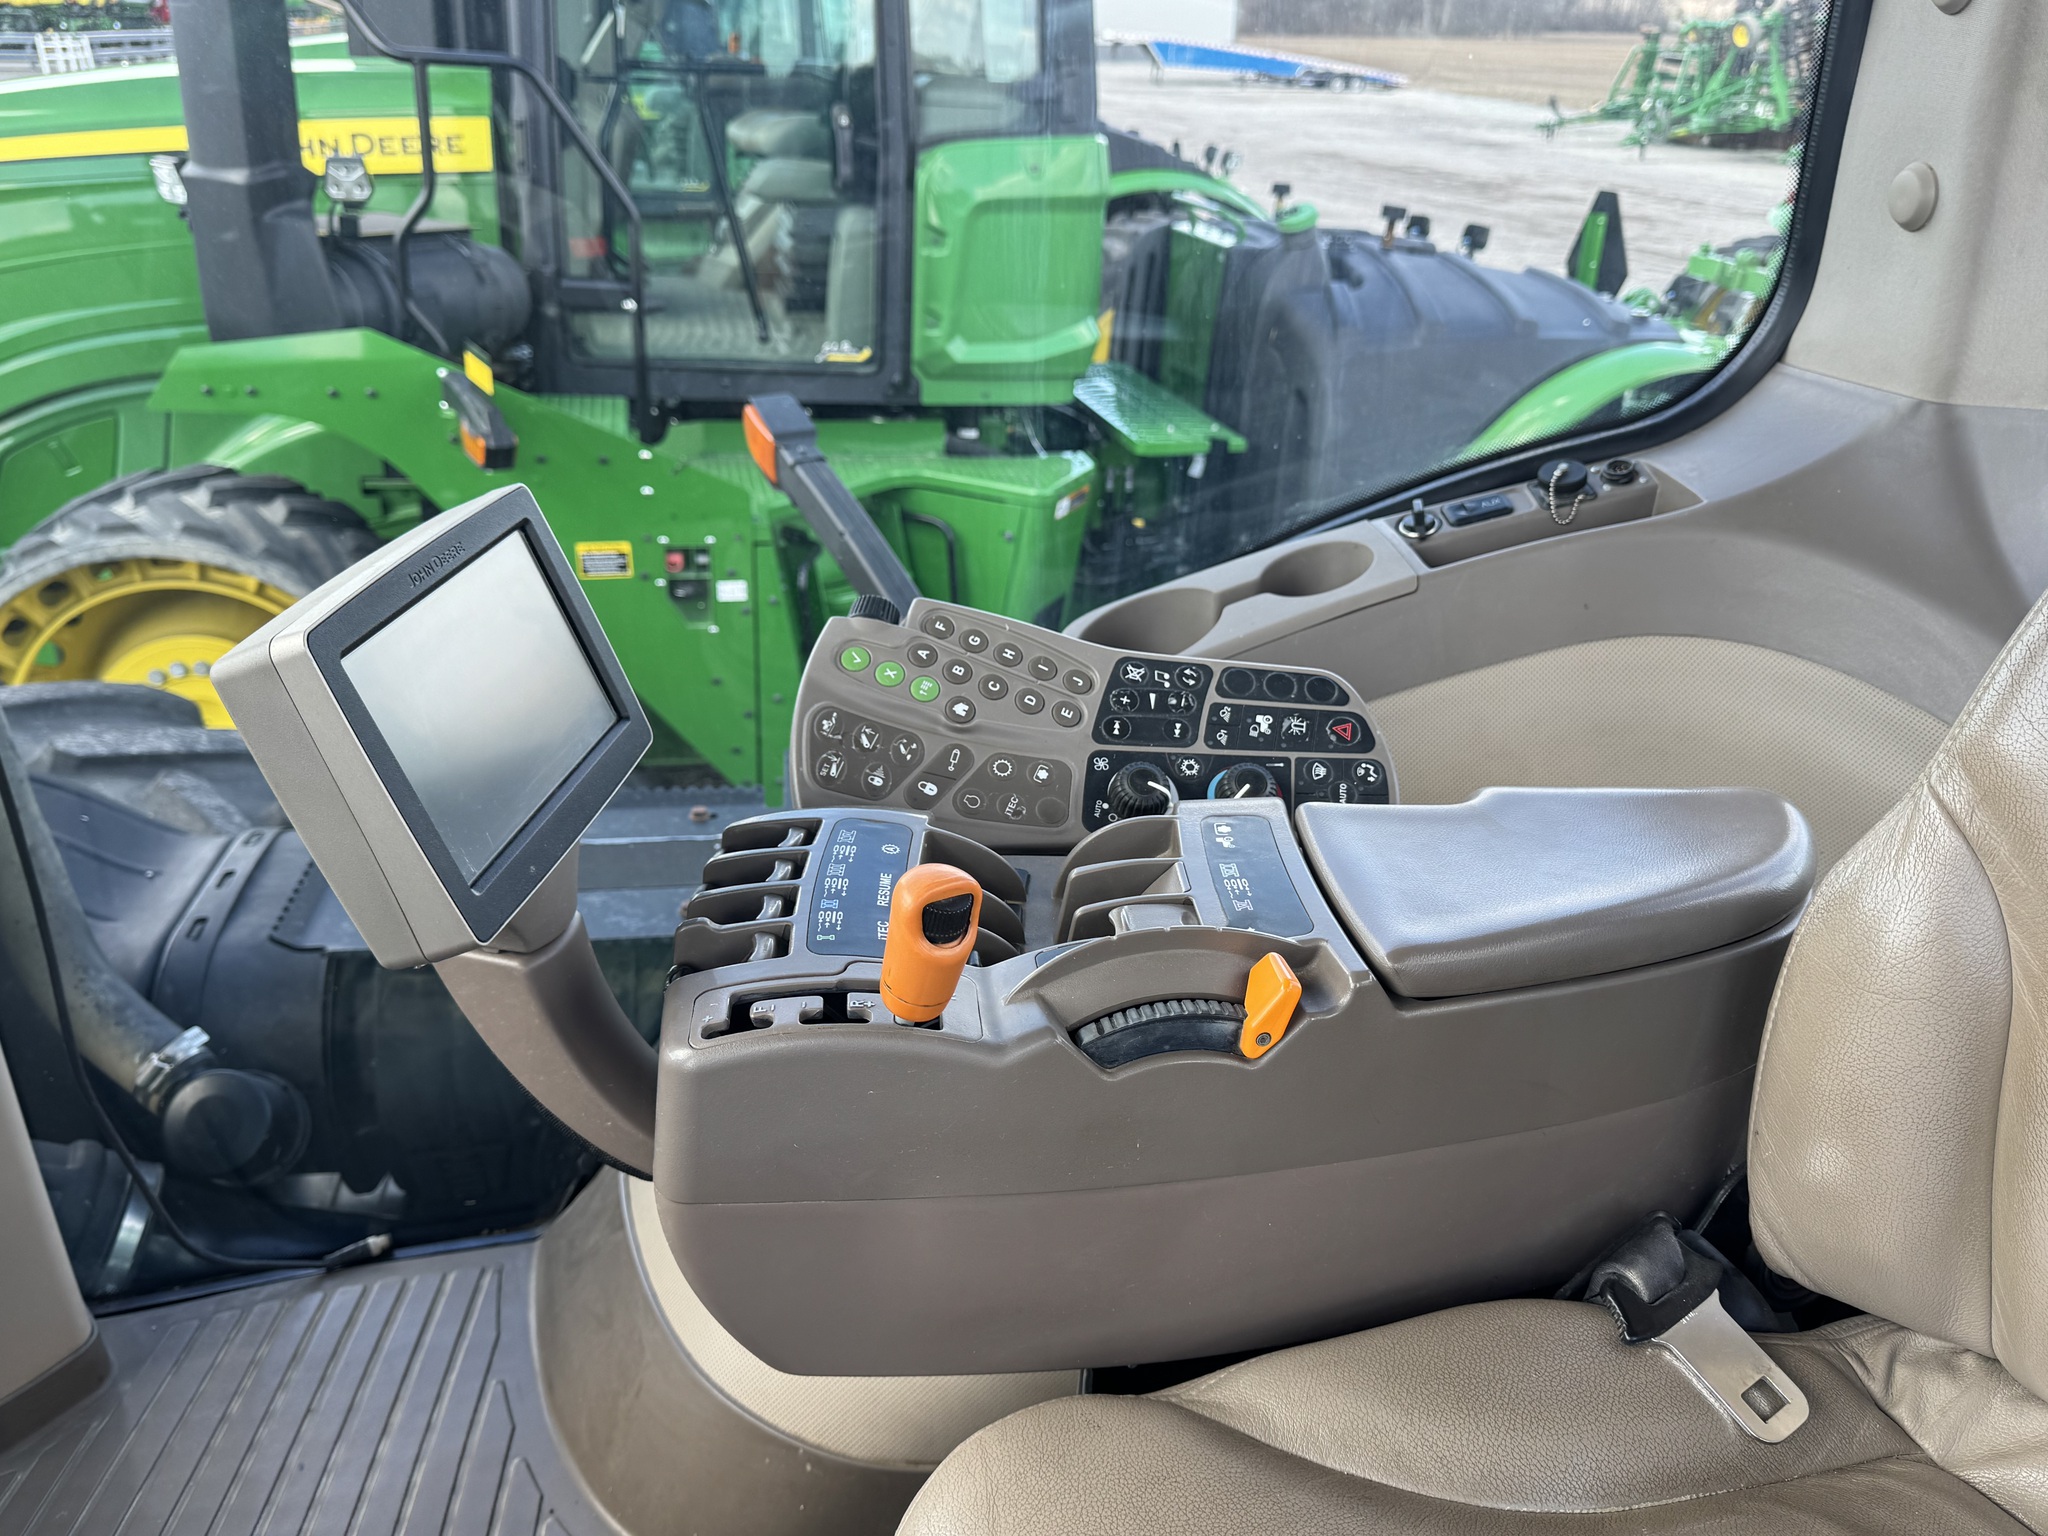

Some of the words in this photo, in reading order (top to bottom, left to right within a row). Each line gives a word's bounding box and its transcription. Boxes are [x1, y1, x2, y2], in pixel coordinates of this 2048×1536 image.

[300, 137, 339, 156] HN
[352, 133, 465, 155] DEERE
[408, 560, 435, 589] JOHN
[432, 542, 466, 568] DEERE
[934, 620, 946, 631] F
[968, 635, 981, 646] G
[917, 649, 930, 660] A
[1002, 648, 1016, 660] H
[951, 665, 965, 676] B
[988, 681, 1000, 691] C
[1072, 676, 1084, 686] J
[1024, 695, 1036, 706] D
[1060, 707, 1074, 719] E
[820, 763, 830, 776] SET
[1339, 783, 1347, 804] AUTO
[1094, 799, 1103, 818] AUTO
[876, 872, 892, 906] RESUME
